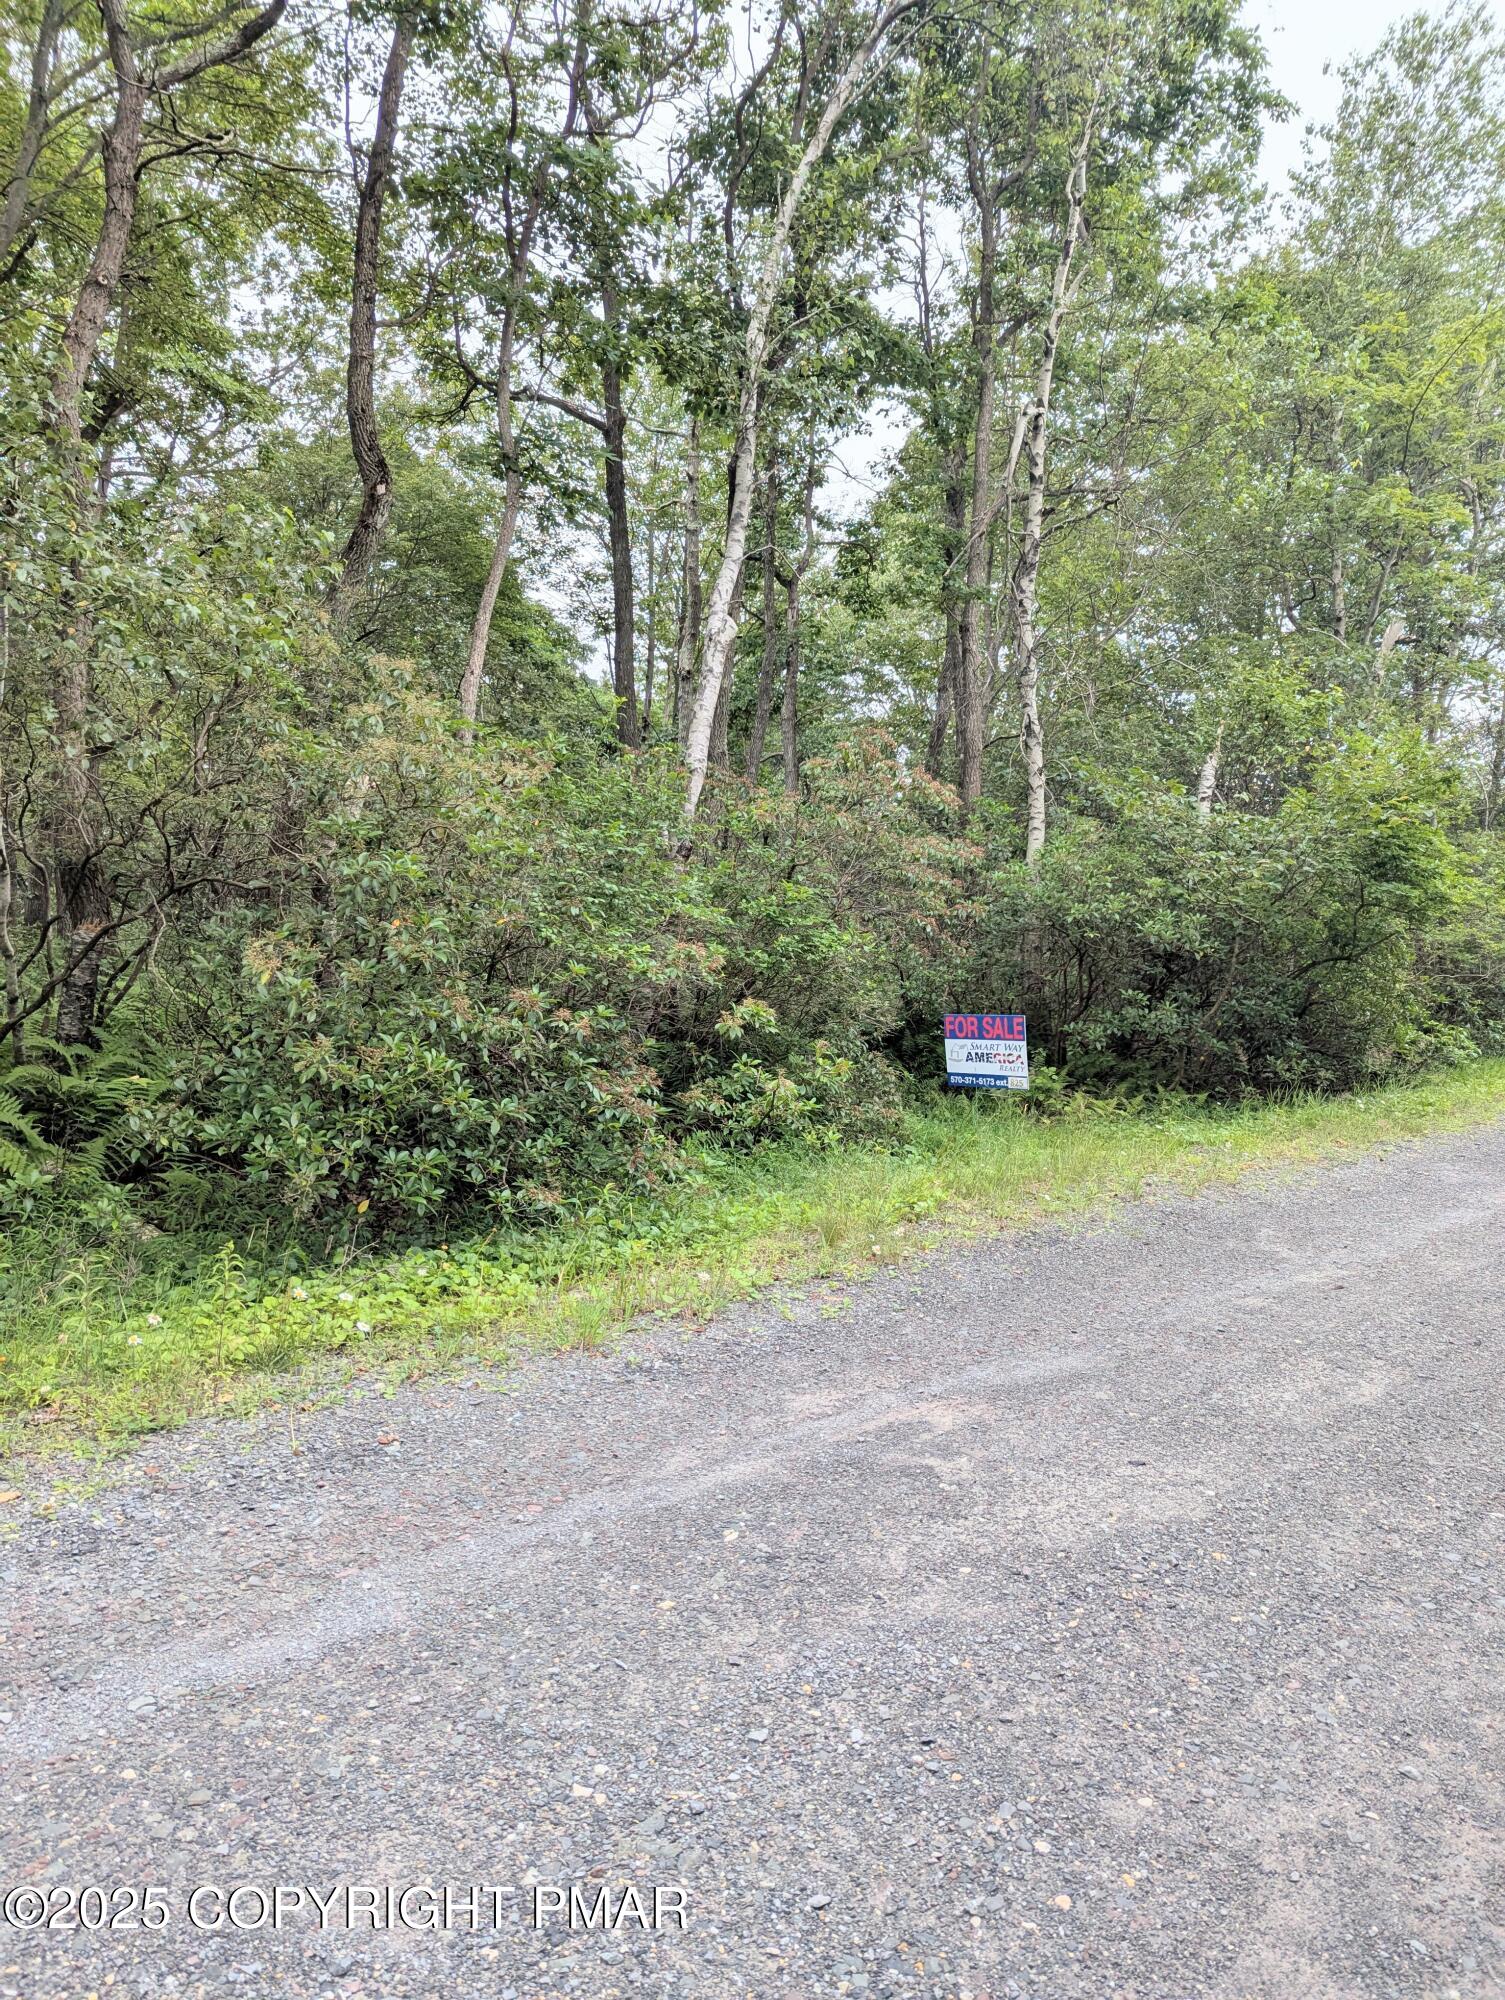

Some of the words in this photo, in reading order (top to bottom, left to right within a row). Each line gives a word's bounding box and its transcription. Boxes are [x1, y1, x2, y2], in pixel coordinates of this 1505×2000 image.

[945, 1015, 978, 1038] FOR
[982, 1016, 1024, 1039] SALE
[970, 1042, 1001, 1051] SMART
[1004, 1043, 1024, 1052] WAY
[965, 1052, 1024, 1065] AMERICA
[950, 1075, 995, 1086] 570-371-5173
